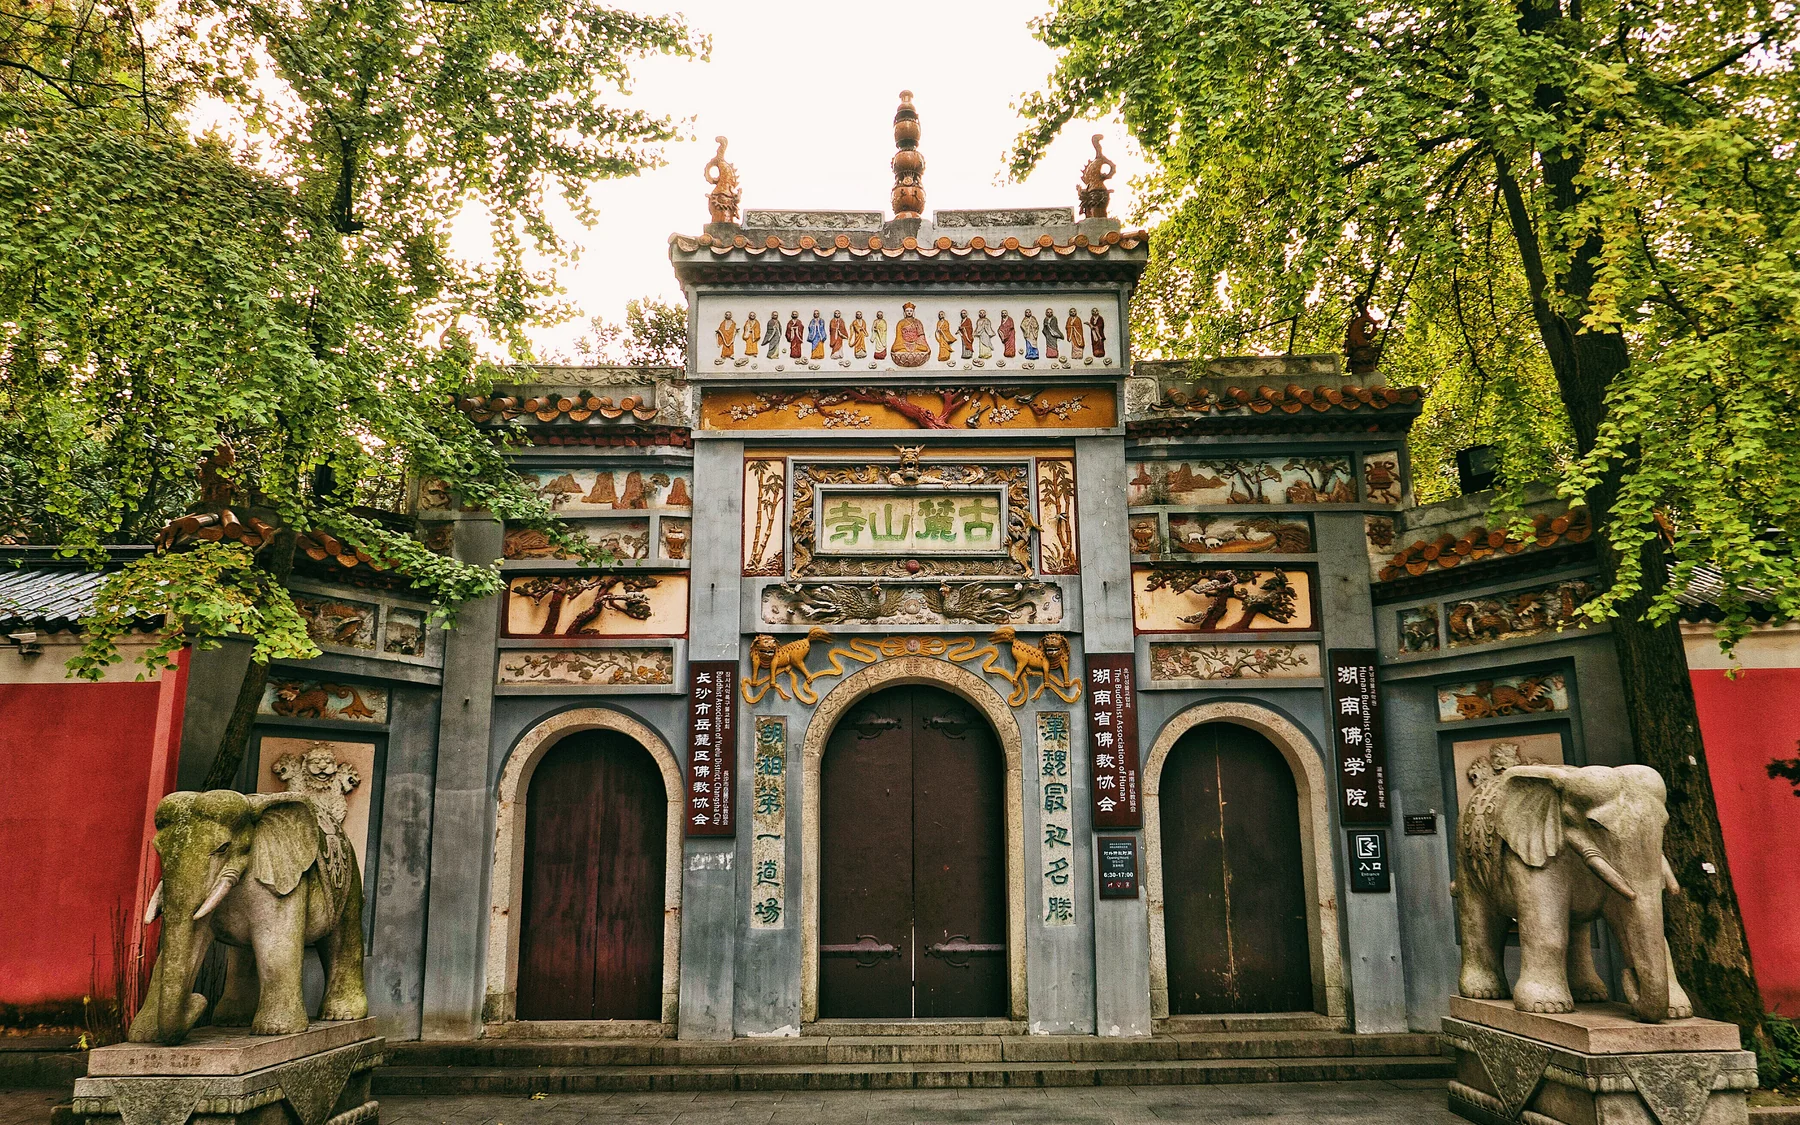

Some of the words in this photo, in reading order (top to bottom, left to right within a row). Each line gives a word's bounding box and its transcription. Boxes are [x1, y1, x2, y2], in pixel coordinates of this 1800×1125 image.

[716, 670, 724, 698] Buddhist
[1114, 668, 1122, 682] The
[1359, 666, 1368, 692] Hunan
[715, 698, 723, 732] Association
[1114, 684, 1123, 718] Buddhist
[1361, 694, 1371, 731] Buddhist
[692, 672, 712, 826] 长沙市岳麓区佛教协会
[714, 740, 722, 758] Yuelu
[1092, 668, 1118, 812] 湖南省佛教协会
[1116, 720, 1125, 765] Association
[1338, 666, 1369, 808] 湖南佛学院
[1364, 732, 1374, 764] College
[713, 758, 722, 782] District,
[1118, 766, 1126, 775] of
[712, 782, 721, 812] Changsha
[1119, 776, 1127, 802] Hunan
[712, 813, 721, 826] City
[1359, 862, 1381, 870] 入口
